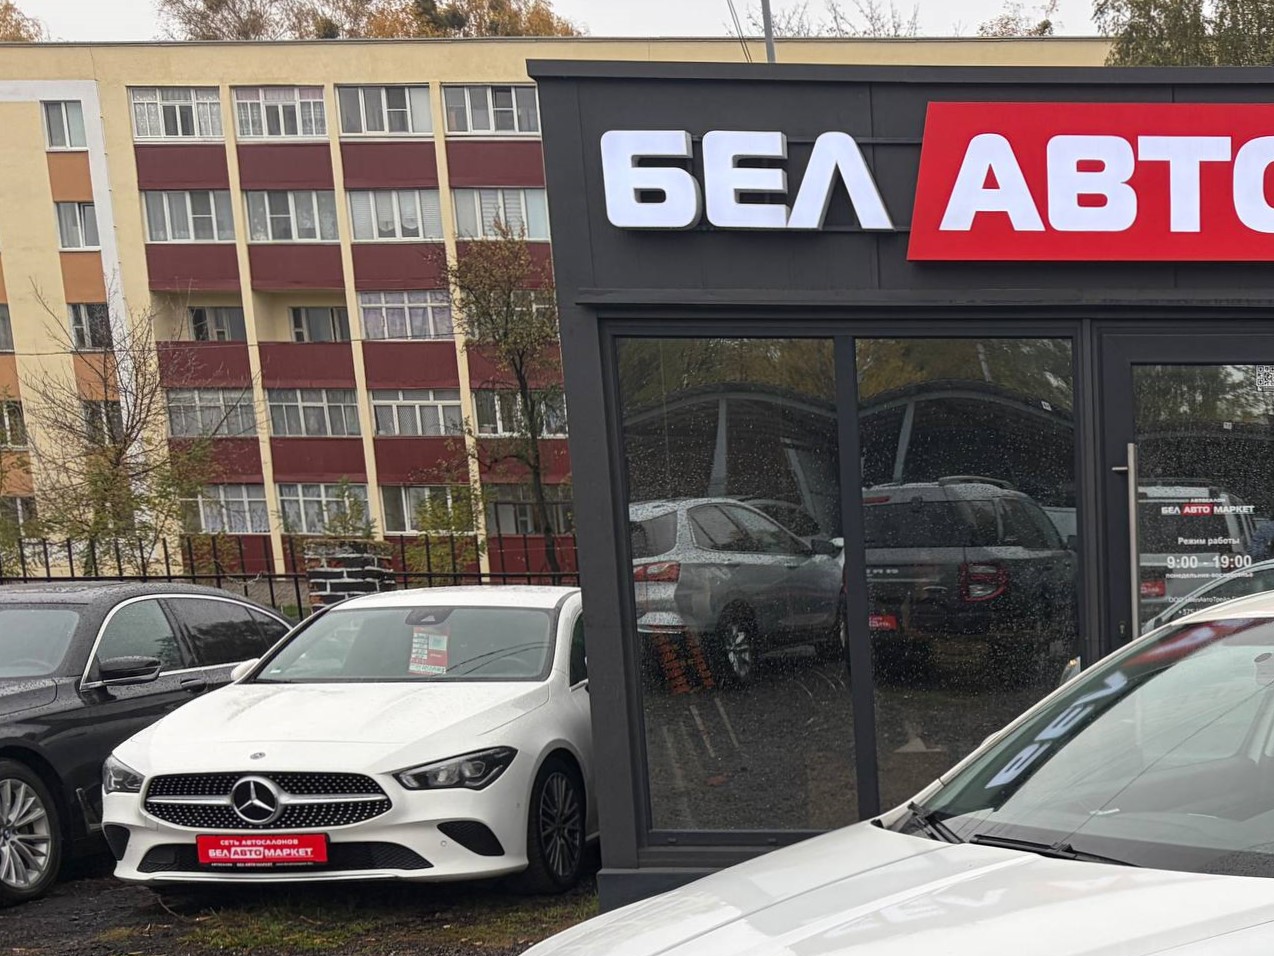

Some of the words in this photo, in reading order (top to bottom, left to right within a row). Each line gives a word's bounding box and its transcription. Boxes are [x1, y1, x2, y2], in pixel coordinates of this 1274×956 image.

[600, 130, 895, 229] БЕЛ
[1161, 506, 1181, 515] БЕЛ
[1183, 505, 1211, 514] АВТО
[1213, 505, 1255, 514] МАРКЕТ
[1178, 537, 1206, 545] Режим
[1208, 536, 1240, 546] работы
[1166, 556, 1199, 569] 9:00
[1212, 555, 1252, 568] 19:00
[209, 849, 230, 857] БЕЛ
[232, 848, 262, 857] АВТО
[264, 848, 313, 857] МАРКЕТ
